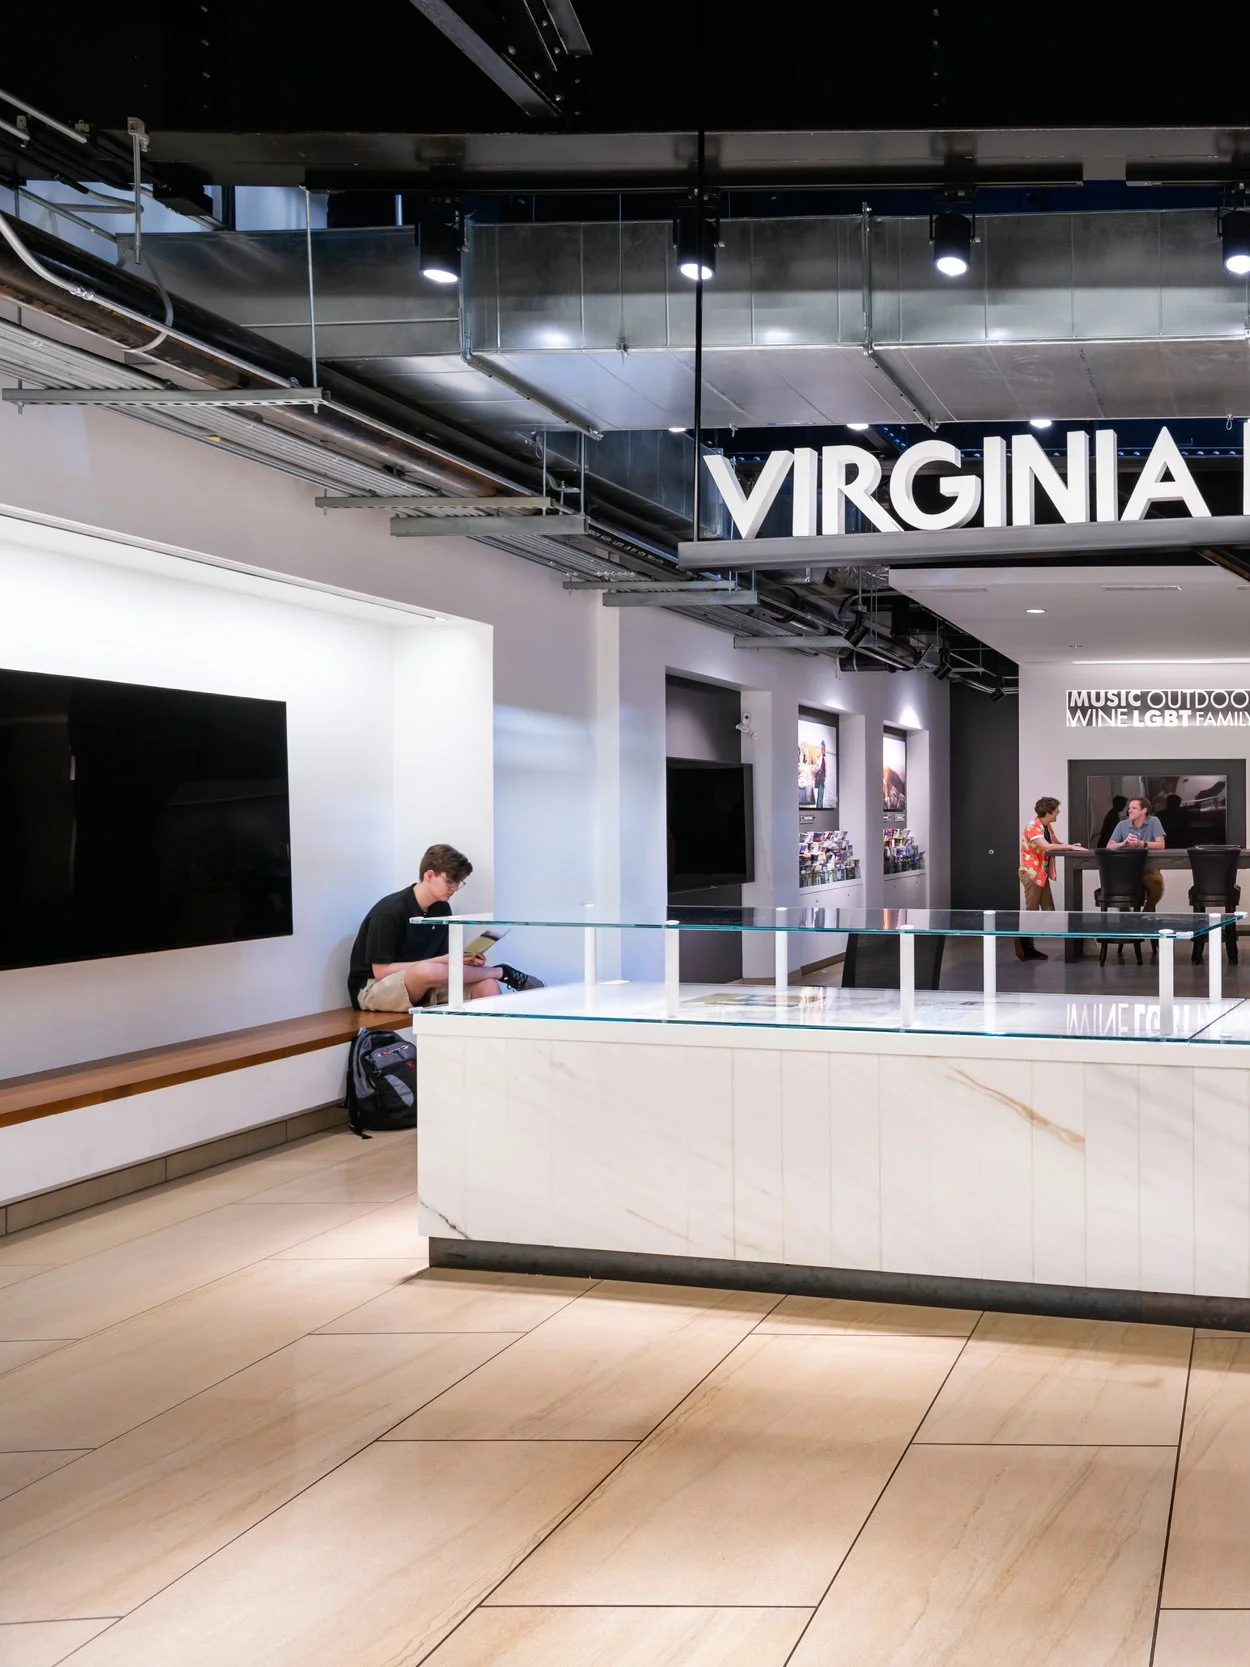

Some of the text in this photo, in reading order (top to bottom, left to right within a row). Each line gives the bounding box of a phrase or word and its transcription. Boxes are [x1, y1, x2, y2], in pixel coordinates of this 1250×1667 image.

[703, 426, 1213, 539] VIRGINIA
[1070, 690, 1142, 707] MUSIC
[1067, 709, 1128, 727] WINE
[1132, 709, 1192, 727] LGBT
